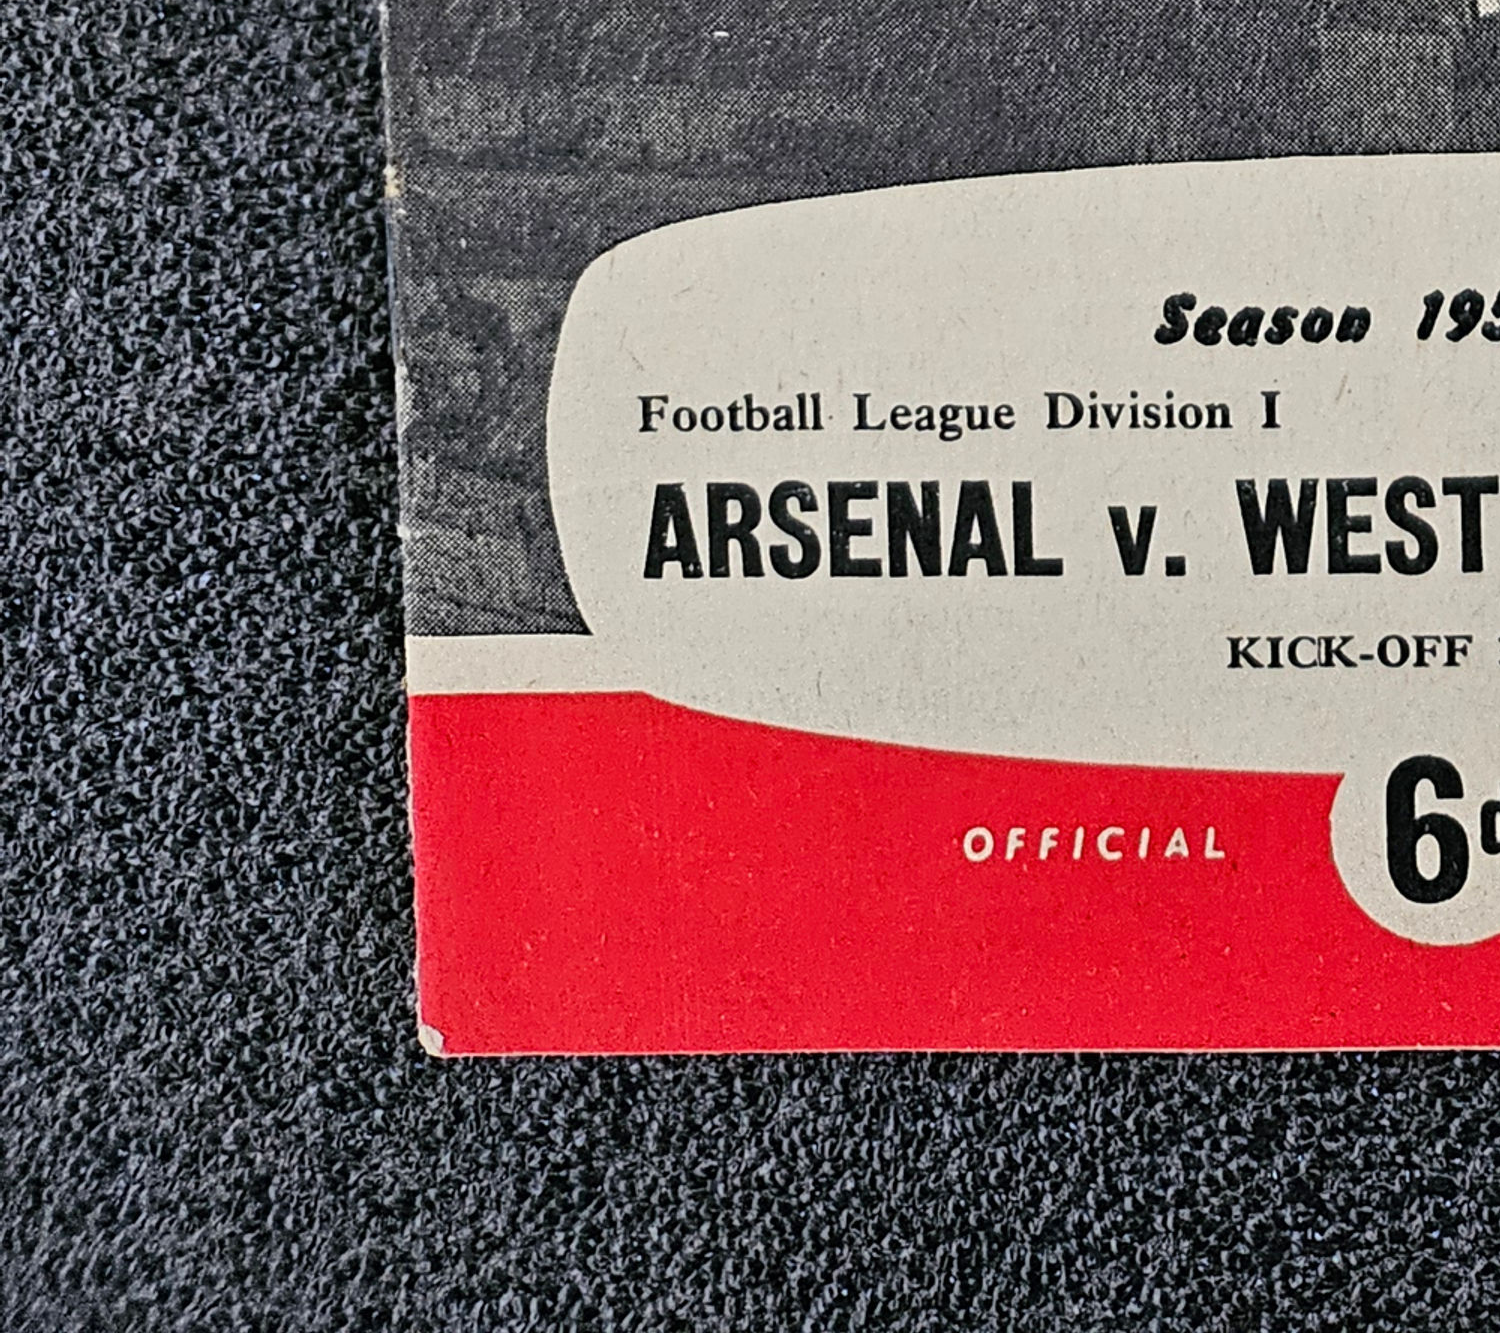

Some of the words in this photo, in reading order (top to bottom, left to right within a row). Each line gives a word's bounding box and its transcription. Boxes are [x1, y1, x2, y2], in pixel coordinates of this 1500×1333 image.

[1152, 291, 1372, 349] Season
[636, 391, 825, 434] Football
[852, 392, 1017, 443] League
[1043, 389, 1234, 431] Division
[1259, 390, 1282, 430] I
[642, 479, 1065, 581] ARSENAL
[1106, 504, 1188, 578] v.
[1234, 474, 1500, 577] WEST
[1225, 633, 1474, 670] KICK-OFF
[962, 825, 1226, 863] OFFICIAL
